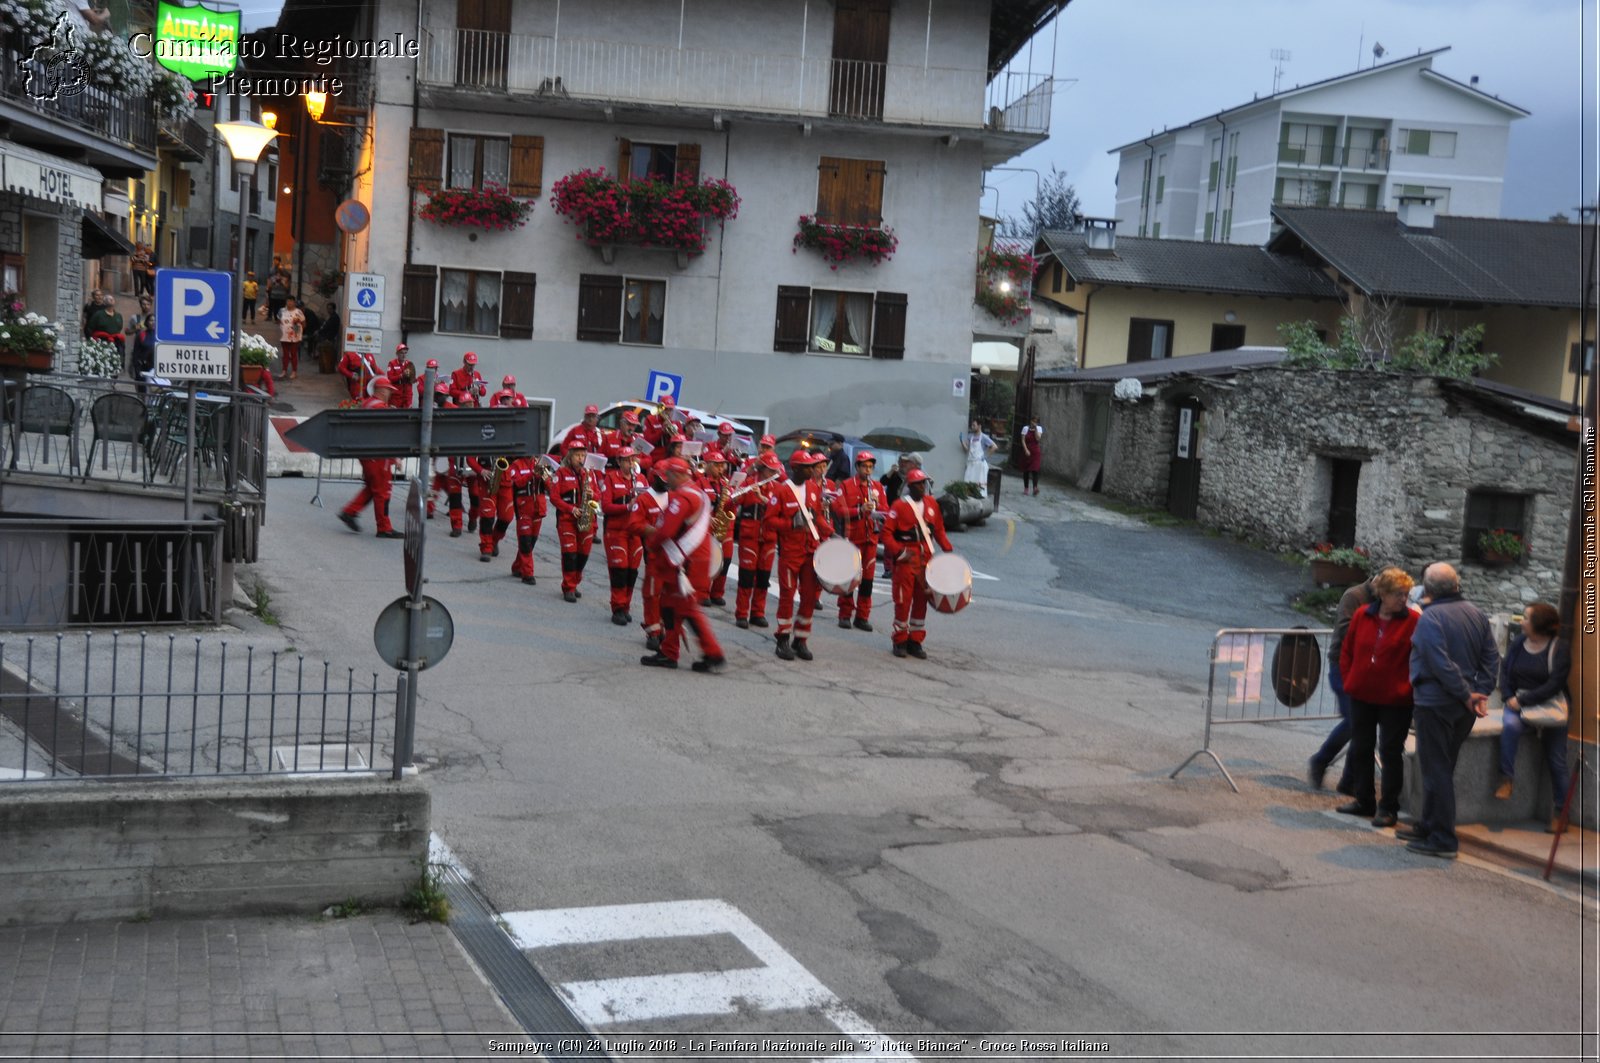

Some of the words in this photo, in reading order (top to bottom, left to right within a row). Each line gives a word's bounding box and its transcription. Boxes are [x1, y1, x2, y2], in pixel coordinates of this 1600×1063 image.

[40, 166, 74, 198] HOTEL
[172, 277, 216, 336] P
[158, 362, 228, 376] RISTORANTE
[176, 349, 210, 361] HOTEL
[651, 374, 675, 403] P
